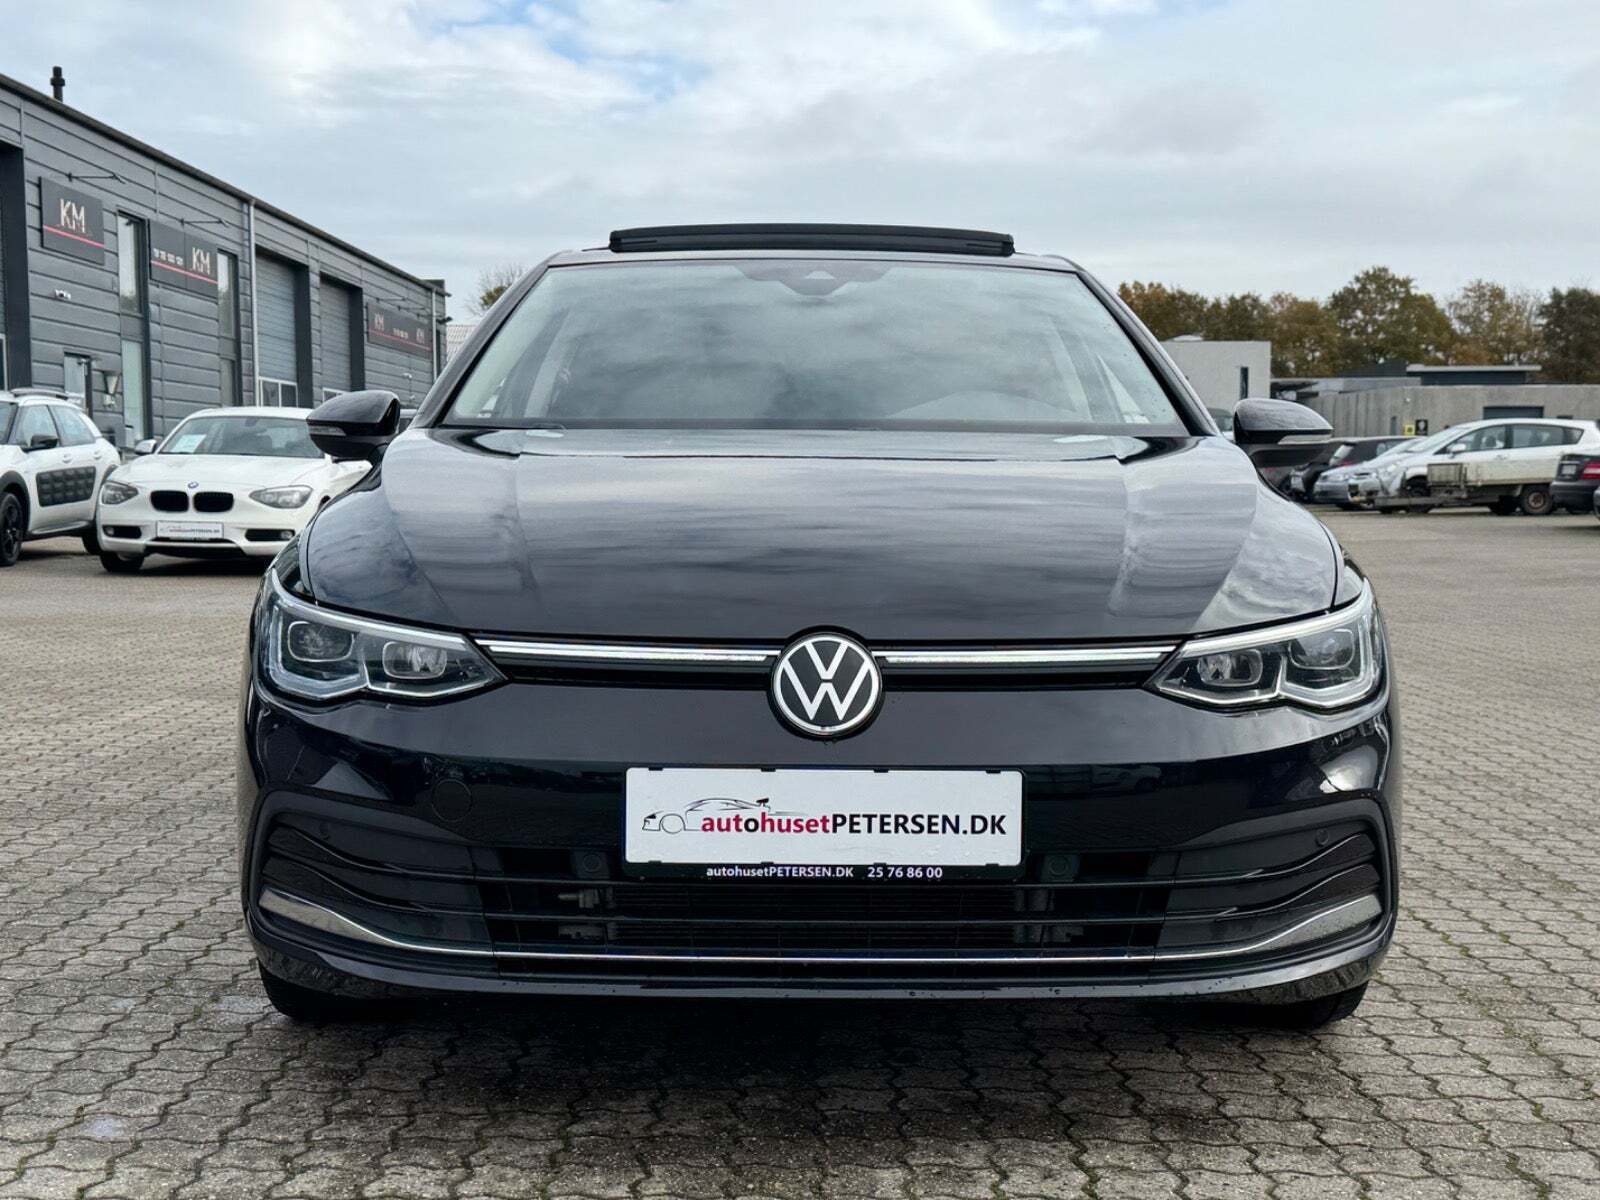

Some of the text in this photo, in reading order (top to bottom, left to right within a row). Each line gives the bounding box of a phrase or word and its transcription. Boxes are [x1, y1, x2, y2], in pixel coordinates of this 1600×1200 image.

[59, 198, 86, 233] KM
[191, 246, 211, 275] KM
[701, 811, 1007, 836] autohusetPETERSEN.DK
[706, 865, 943, 879] autohusetPETERSEN.DK 25 76 86 00
